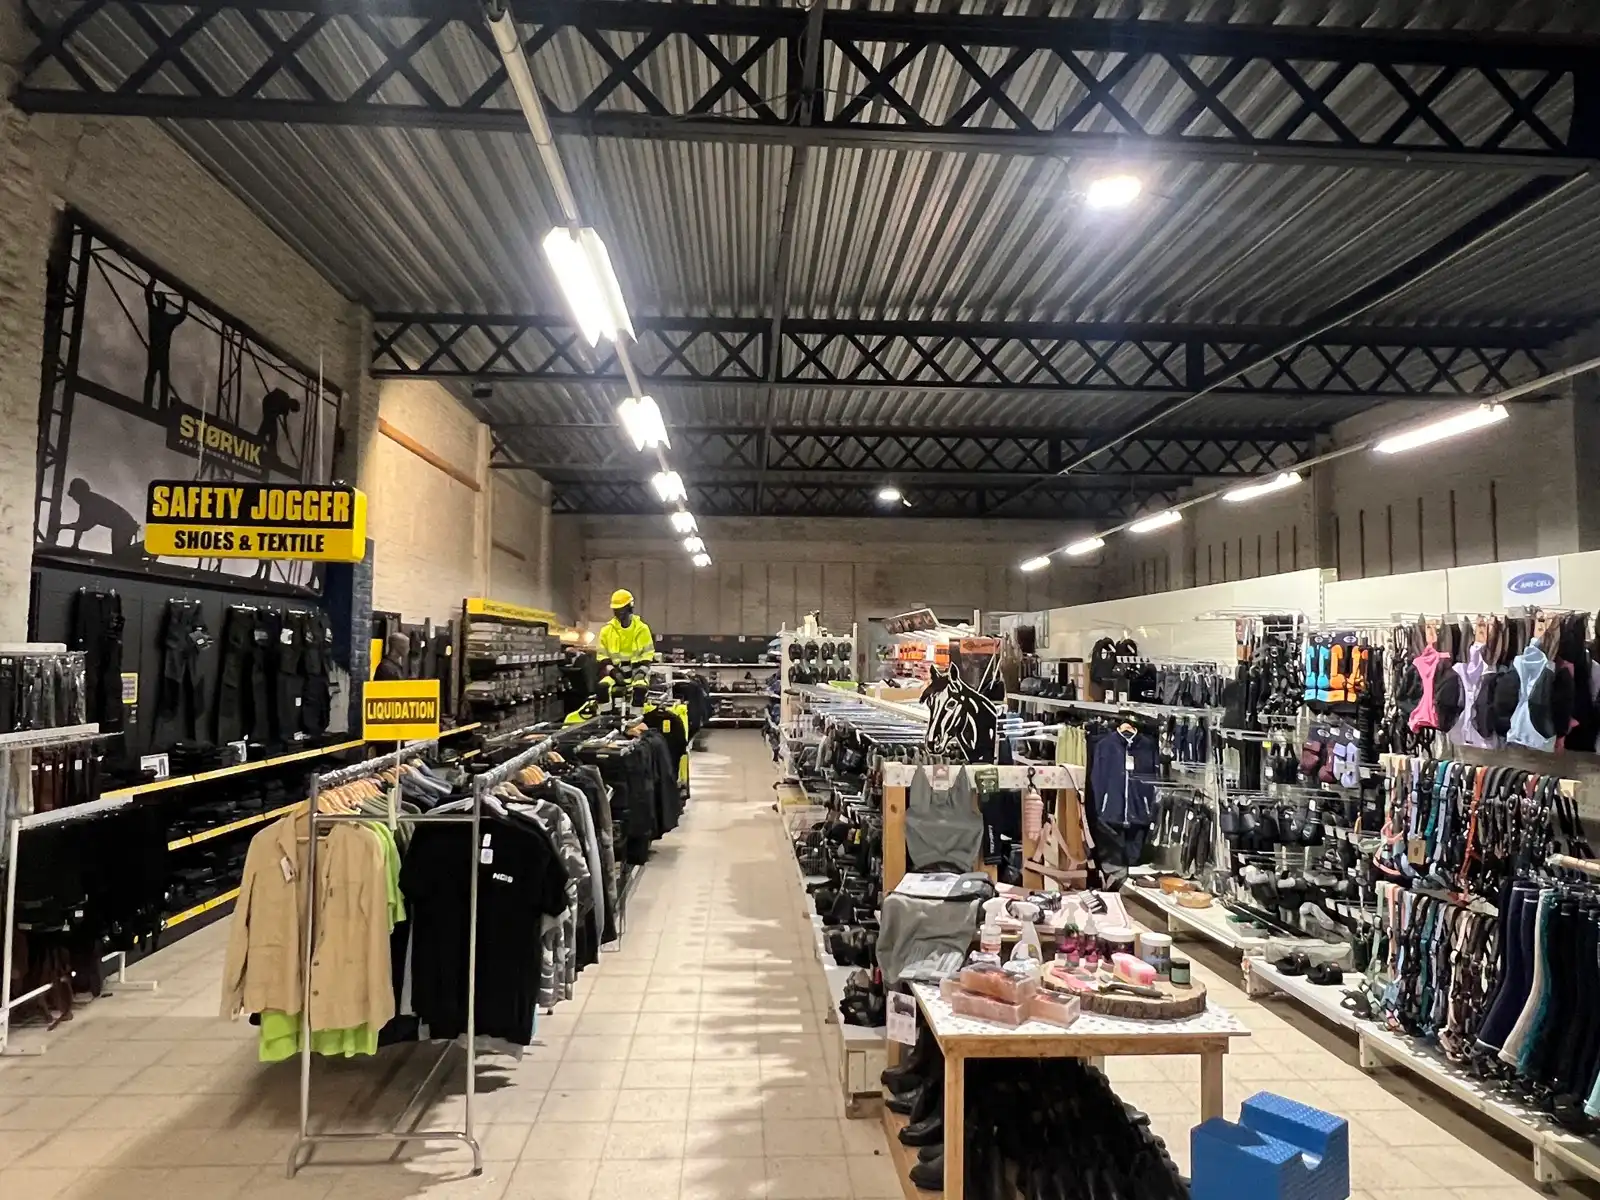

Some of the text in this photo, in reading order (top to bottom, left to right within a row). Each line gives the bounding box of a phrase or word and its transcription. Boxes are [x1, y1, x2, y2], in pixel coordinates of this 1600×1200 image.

[180, 414, 261, 466] STØRVIK
[152, 485, 350, 523] SAFETY JOGGER
[174, 530, 325, 553] SHOES & TEXTILE
[367, 701, 435, 720] LIQUIDATION
